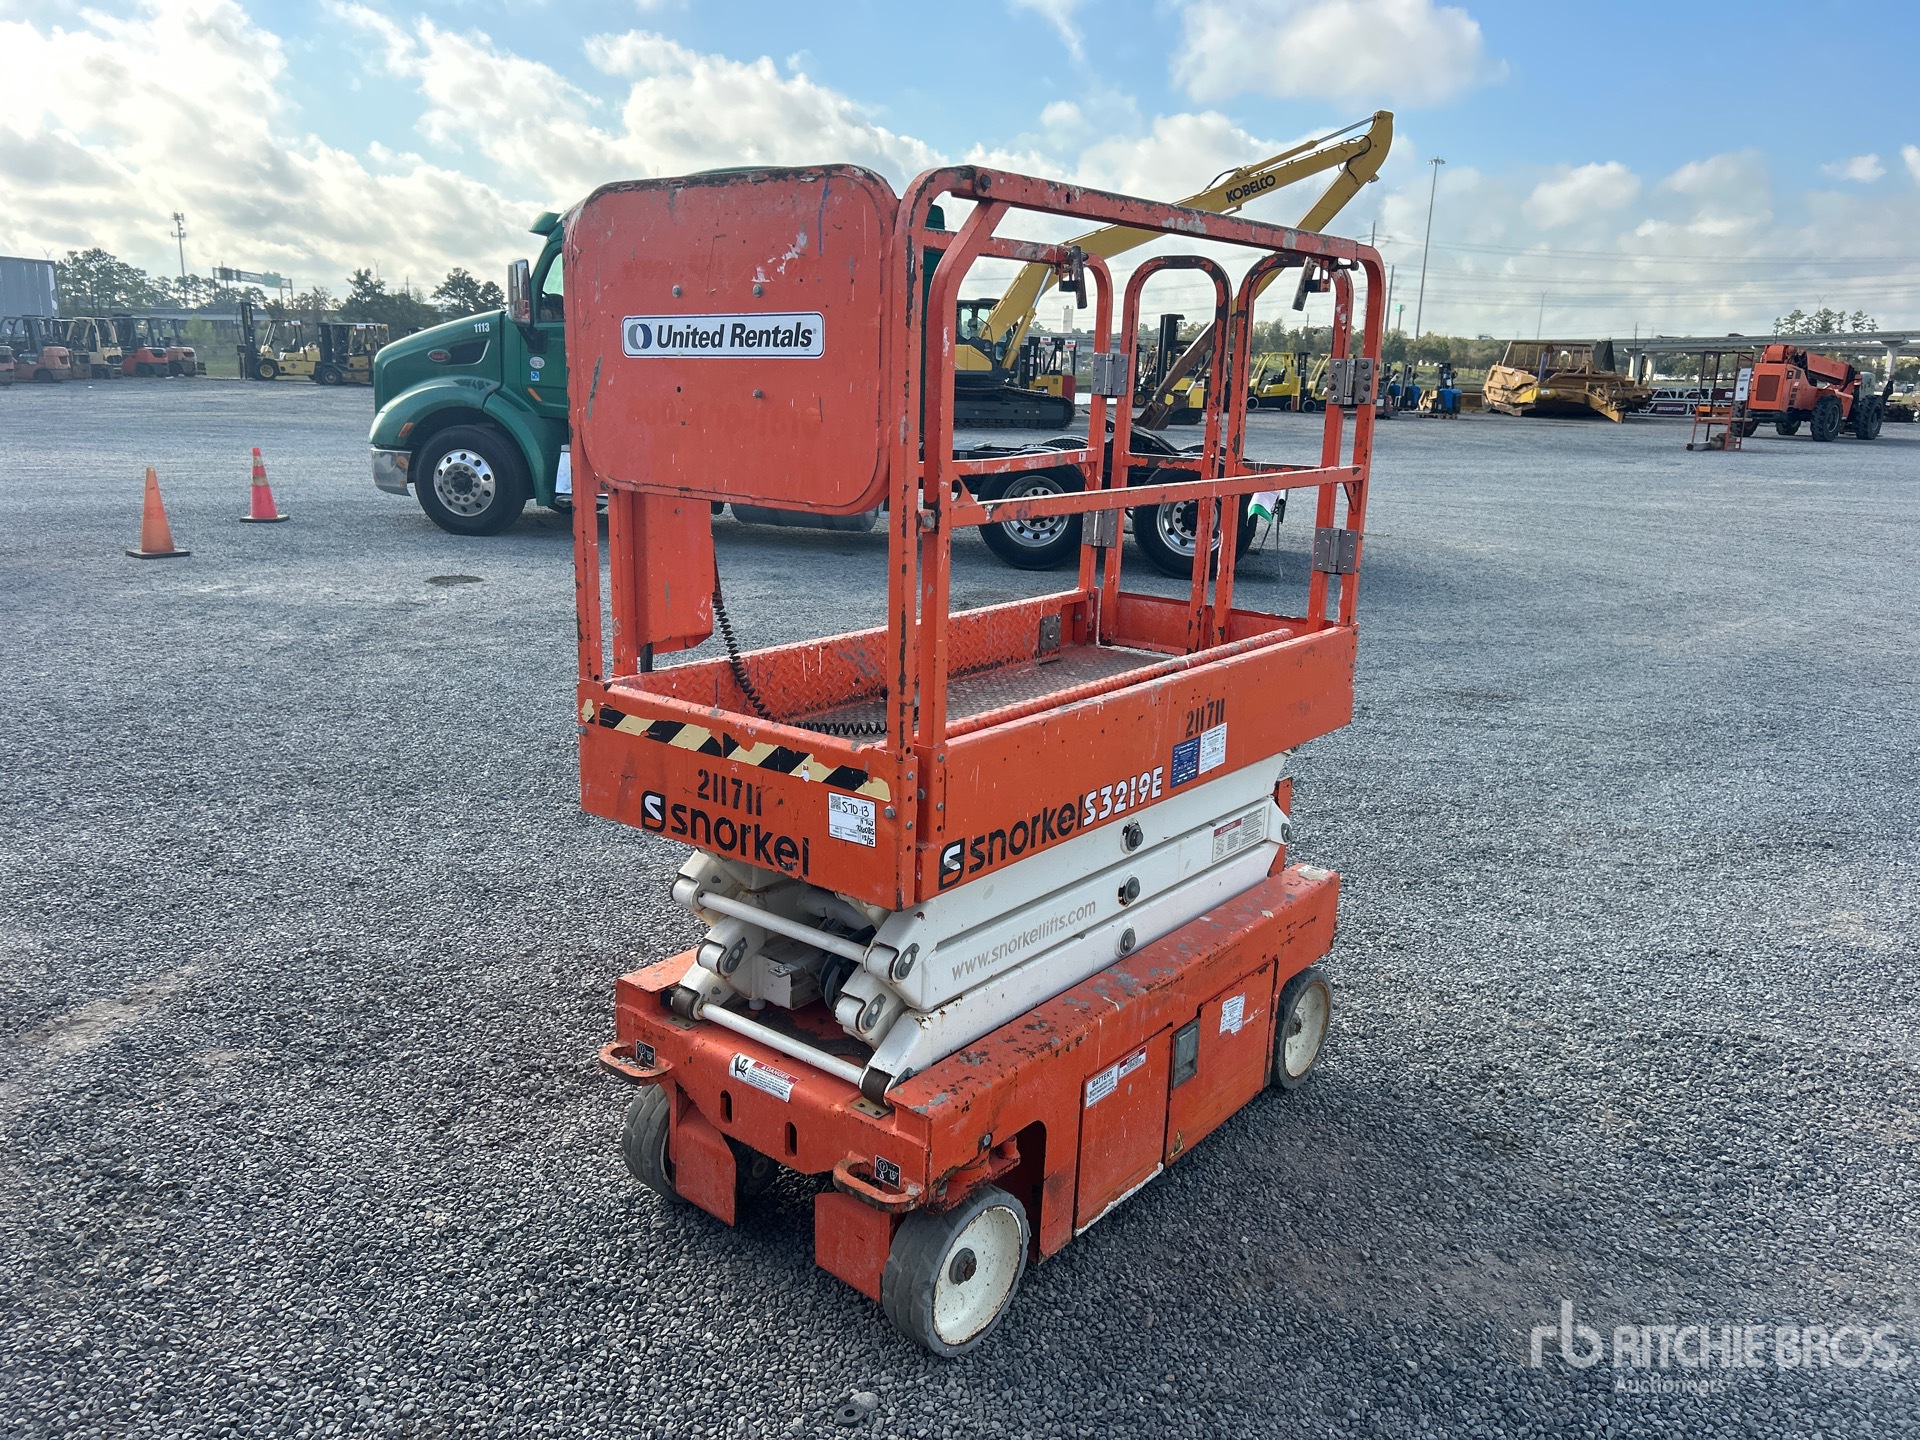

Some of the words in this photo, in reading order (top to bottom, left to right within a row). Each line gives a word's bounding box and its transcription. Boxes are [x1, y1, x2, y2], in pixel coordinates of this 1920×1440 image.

[1226, 175, 1276, 203] KOBELCO
[474, 322, 490, 333] 1113
[657, 323, 725, 349] United
[1186, 698, 1225, 738] 211711
[697, 768, 762, 816] 211711
[969, 794, 1083, 874] snorkel
[1083, 766, 1164, 827] S3219E
[670, 803, 809, 877] snorkel
[951, 901, 1096, 981] www.snorkellifts.com
[765, 1065, 790, 1080] DANGER
[1091, 1070, 1113, 1088] BATTERY
